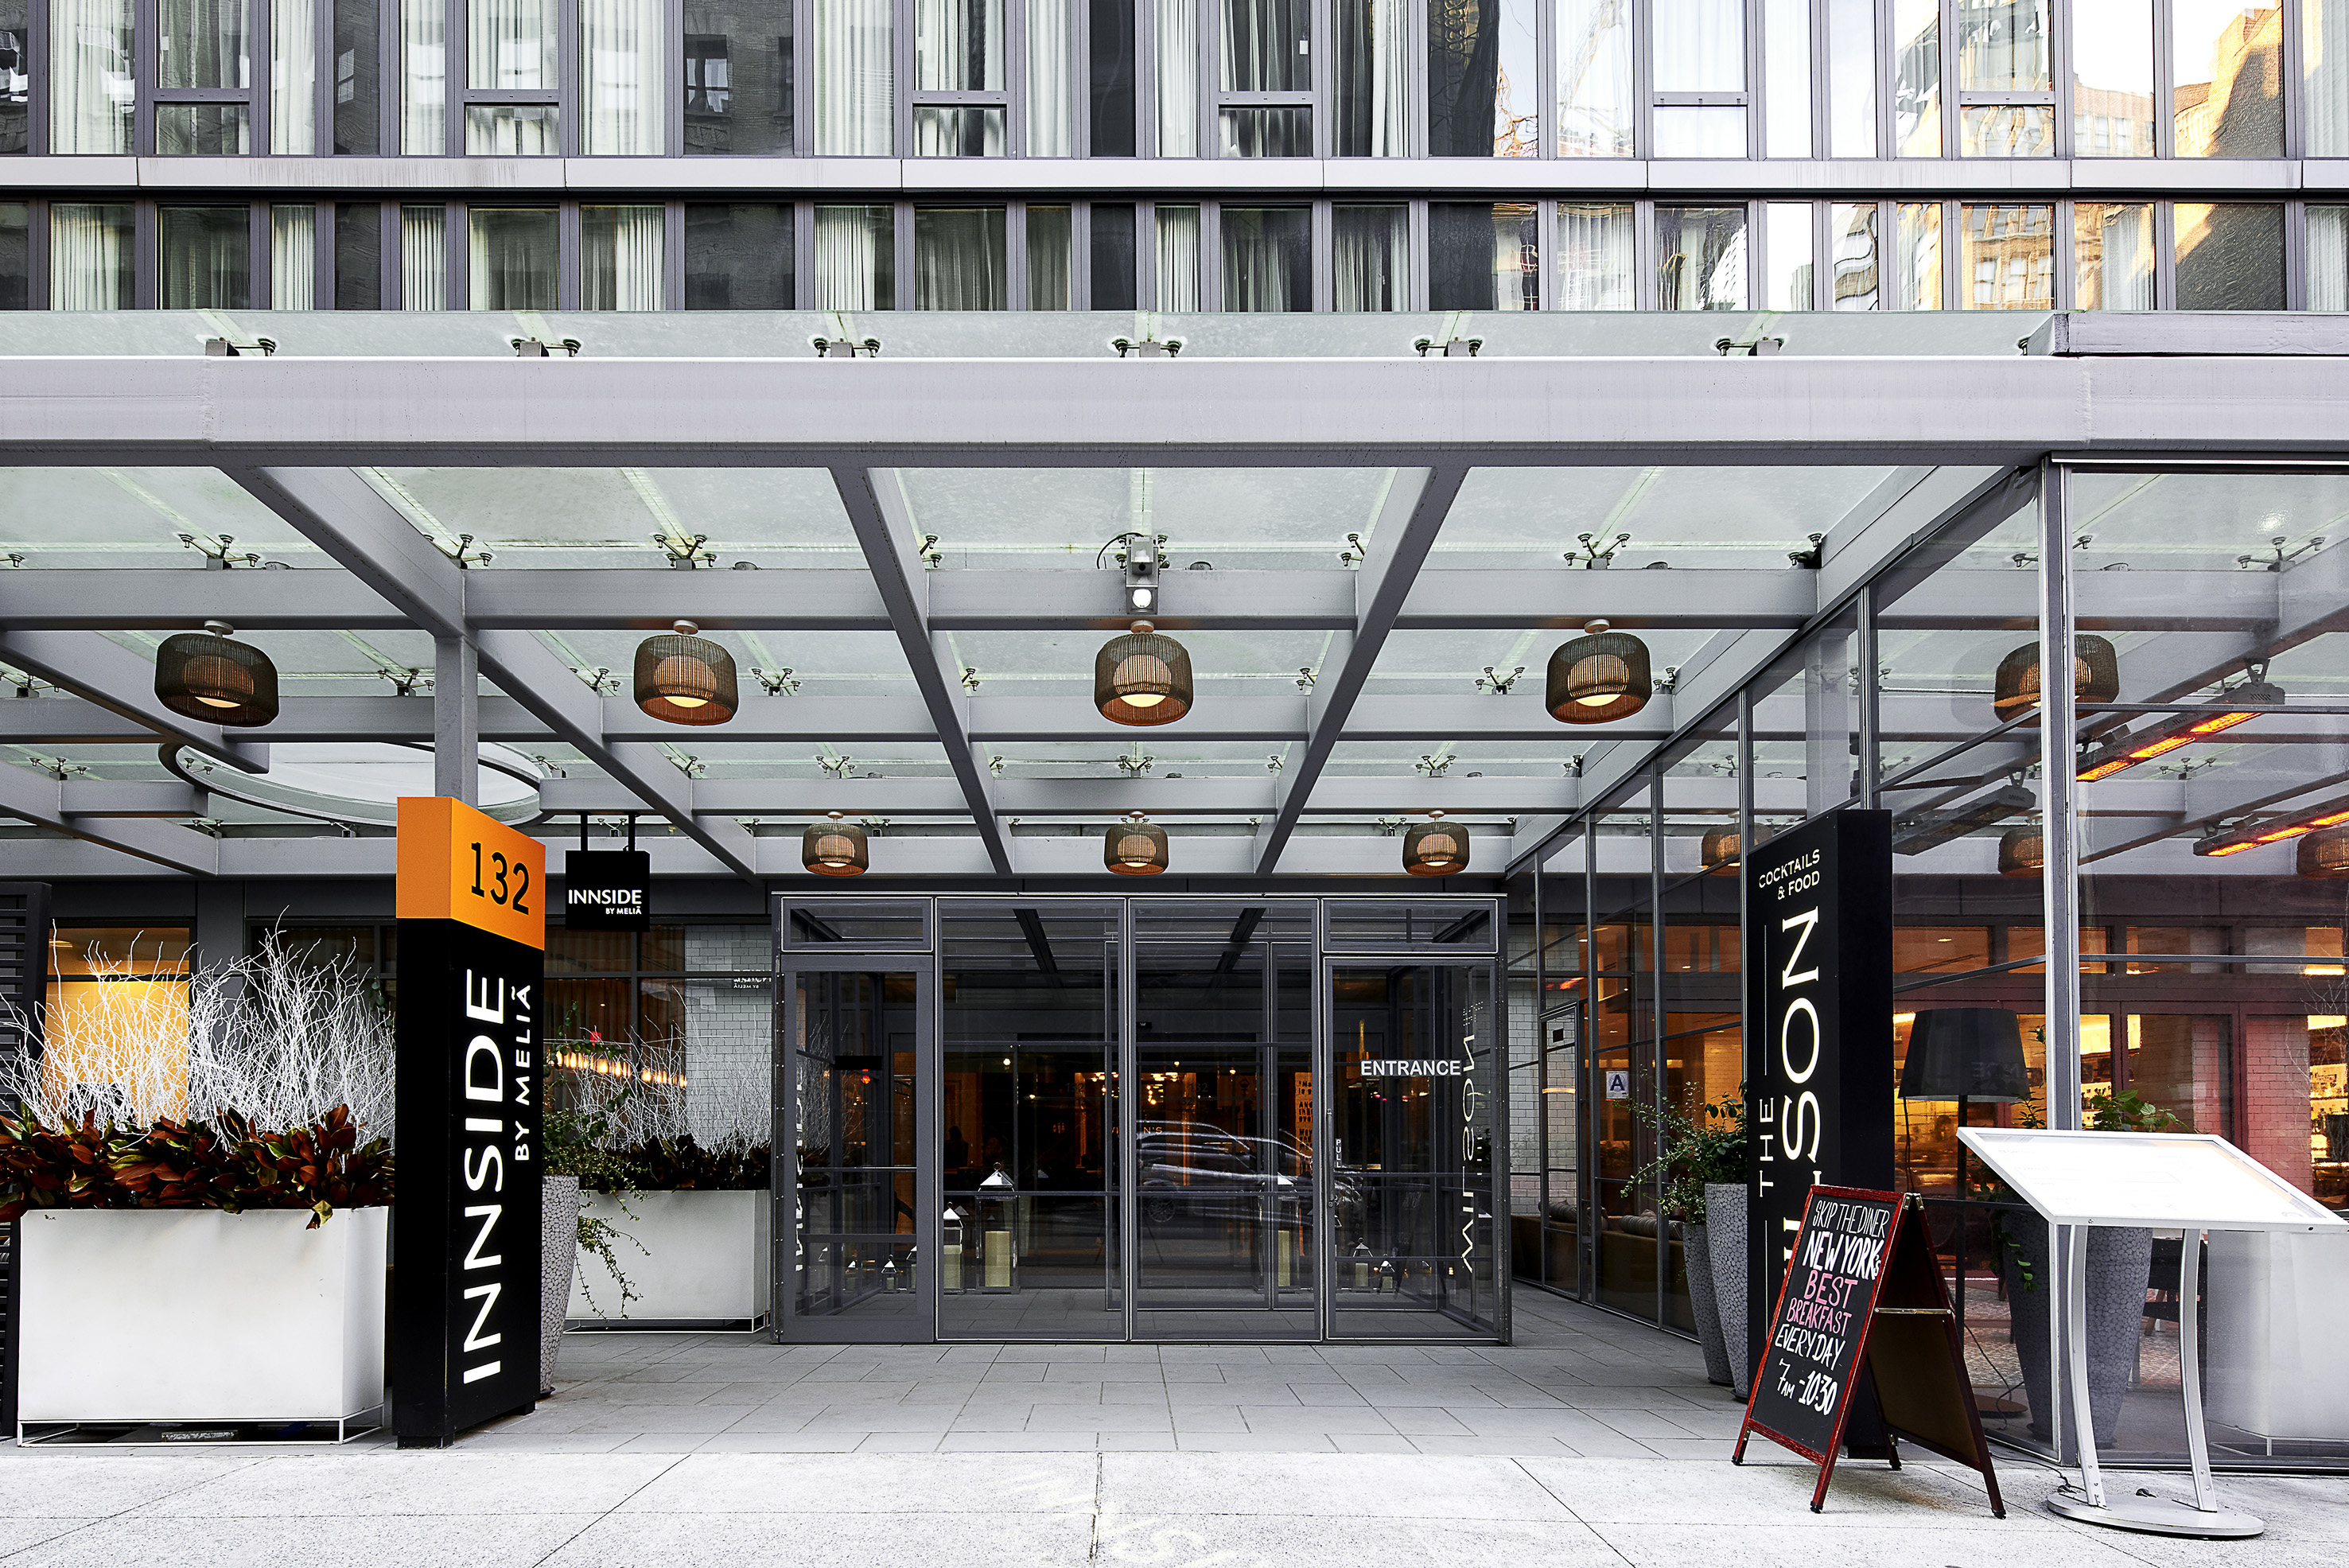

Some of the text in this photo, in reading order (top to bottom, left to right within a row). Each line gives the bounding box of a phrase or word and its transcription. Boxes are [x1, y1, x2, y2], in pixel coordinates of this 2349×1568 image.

[470, 840, 530, 916] 132
[1759, 849, 1820, 889] COCKTAILS
[1777, 870, 1820, 901] & FOOD
[568, 889, 642, 905] INNSIDE
[1361, 1060, 1461, 1076] ENTRANCE
[1609, 1074, 1626, 1091] A
[1782, 905, 1822, 1277] SON
[515, 1119, 530, 1161] BY
[1759, 1097, 1774, 1198] THE
[463, 968, 504, 1384] INNSIDE
[1813, 1200, 1890, 1238] SKIP THE DINER
[1802, 1230, 1845, 1271] NEW
[1803, 1270, 1858, 1309] BEST
[1786, 1298, 1852, 1336] BREAKFAST
